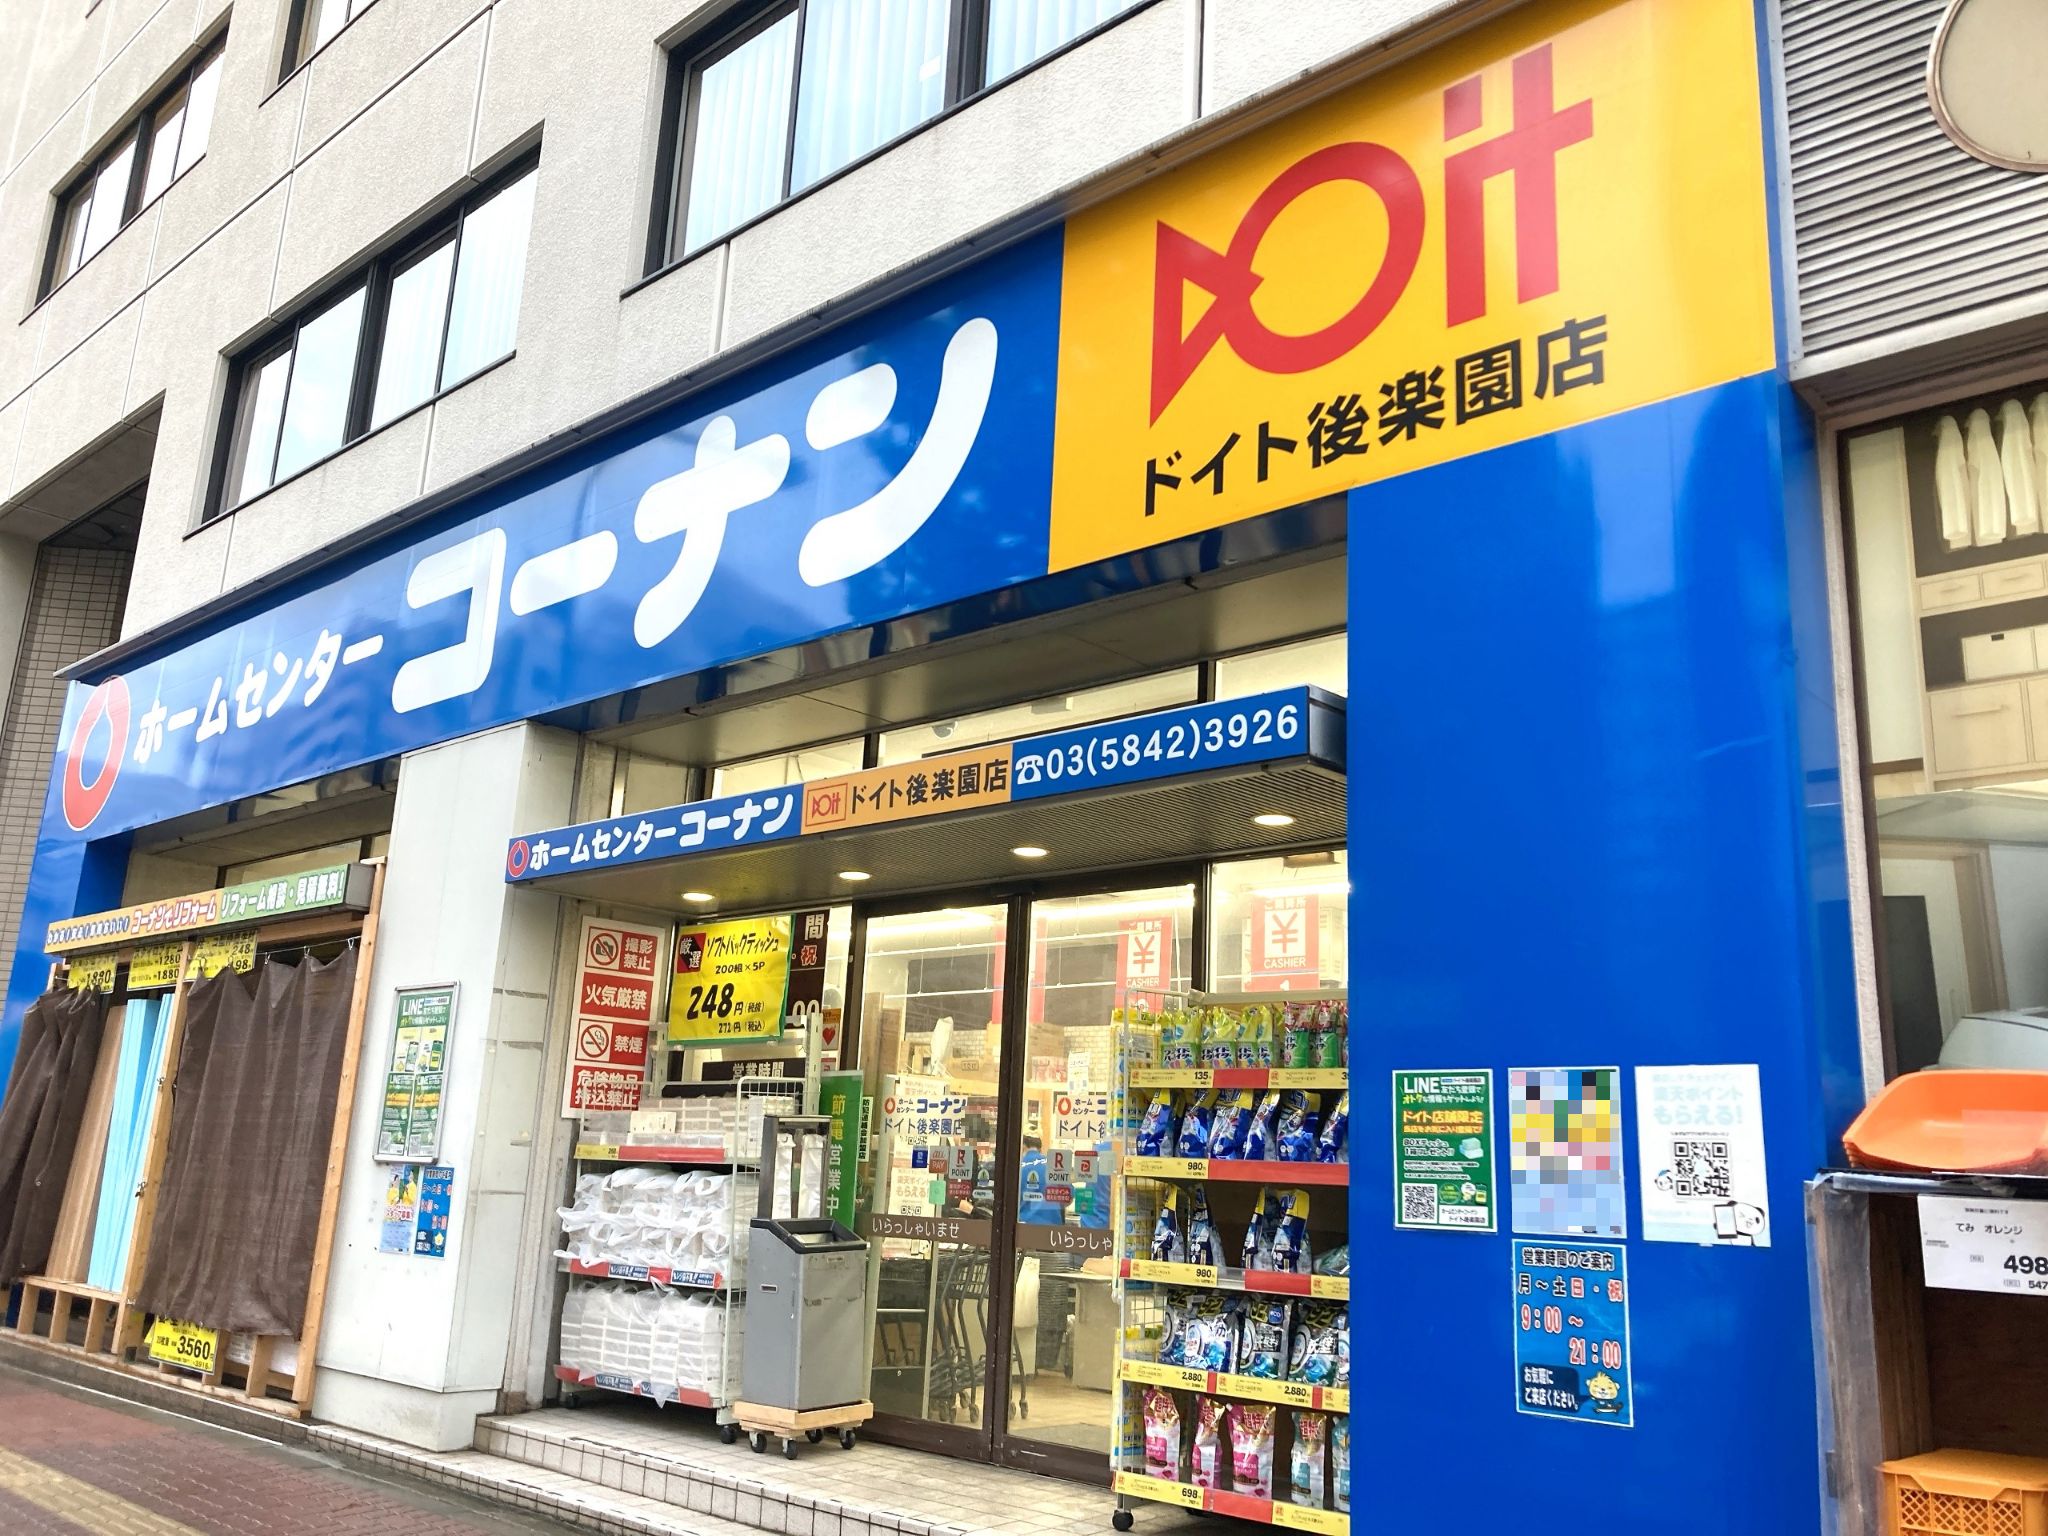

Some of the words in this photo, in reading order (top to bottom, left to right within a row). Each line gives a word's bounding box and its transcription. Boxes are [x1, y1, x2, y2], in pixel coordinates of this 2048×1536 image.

[1145, 315, 1607, 516] ドイト後楽園店
[133, 628, 384, 764] ホームセンター
[391, 317, 998, 714] コーナン
[1046, 704, 1298, 780] 03(5842)3926
[530, 826, 676, 869] ホームセンター
[679, 793, 794, 847] コーナン
[851, 759, 1008, 815] ドイト後楽園店
[805, 914, 825, 940] 間
[624, 936, 653, 955] 撮影
[159, 954, 181, 965] 1280
[623, 953, 651, 971] 禁止
[1264, 957, 1305, 969] CASHIER
[158, 968, 179, 981] 1880
[1125, 977, 1160, 988] CASHIER
[584, 983, 648, 1011] 火気厳禁
[402, 998, 424, 1016] LINE
[614, 1034, 643, 1054] 禁煙
[733, 1061, 785, 1078] 営業時間
[1194, 1072, 1208, 1080] 135
[577, 1068, 639, 1090] 危険物品
[1403, 1077, 1440, 1093] LINE
[574, 1088, 640, 1108] 持込禁止
[916, 1098, 966, 1114] コーナン
[1075, 1098, 1093, 1106] ホーム
[1072, 1107, 1095, 1115] センター
[951, 1169, 970, 1177] POINT
[1187, 1162, 1203, 1170] 980
[1048, 1173, 1069, 1182] POINT
[872, 1218, 960, 1238] いらっしゃいませ
[1955, 1223, 1975, 1232] てみ
[1984, 1224, 2023, 1235] オレンジ
[1050, 1230, 1112, 1250] いらっしゃ
[1522, 1246, 1615, 1271] 営業時間のご案内
[2003, 1255, 2048, 1276] 498
[1196, 1268, 1211, 1278] 980
[177, 1335, 211, 1360] 3560
[1569, 1337, 1622, 1369] 21:00
[1523, 1367, 1554, 1384] お気軽に
[1182, 1487, 1198, 1499] 698
